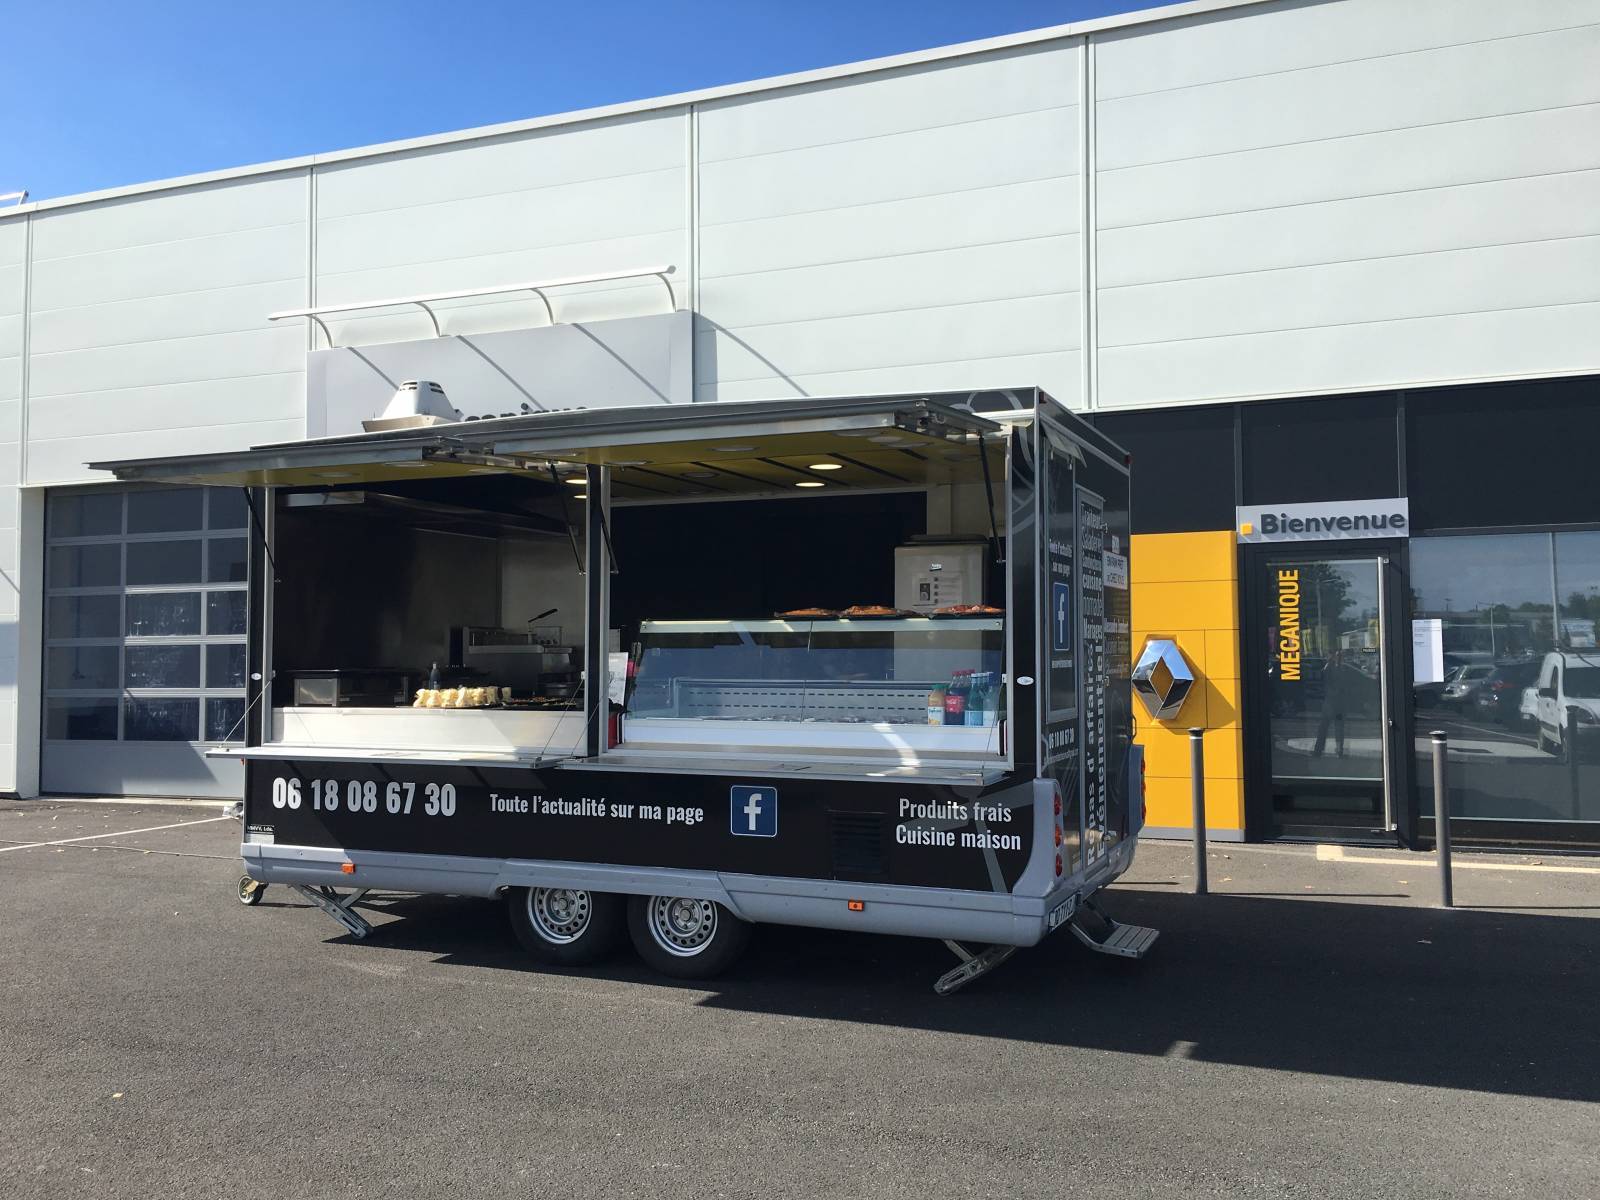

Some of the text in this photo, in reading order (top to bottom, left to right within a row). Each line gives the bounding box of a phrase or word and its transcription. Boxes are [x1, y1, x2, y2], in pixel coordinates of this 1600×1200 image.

[1260, 513, 1406, 534] Bienvenue
[1083, 617, 1103, 643] Mariages
[273, 777, 456, 817] 06 18 08 67 30
[490, 794, 704, 825] Toute l'actualité sur ma page
[899, 798, 1012, 822] Produits frais
[896, 824, 1021, 850] Cuisine maison
[1087, 782, 1096, 866] Repas
